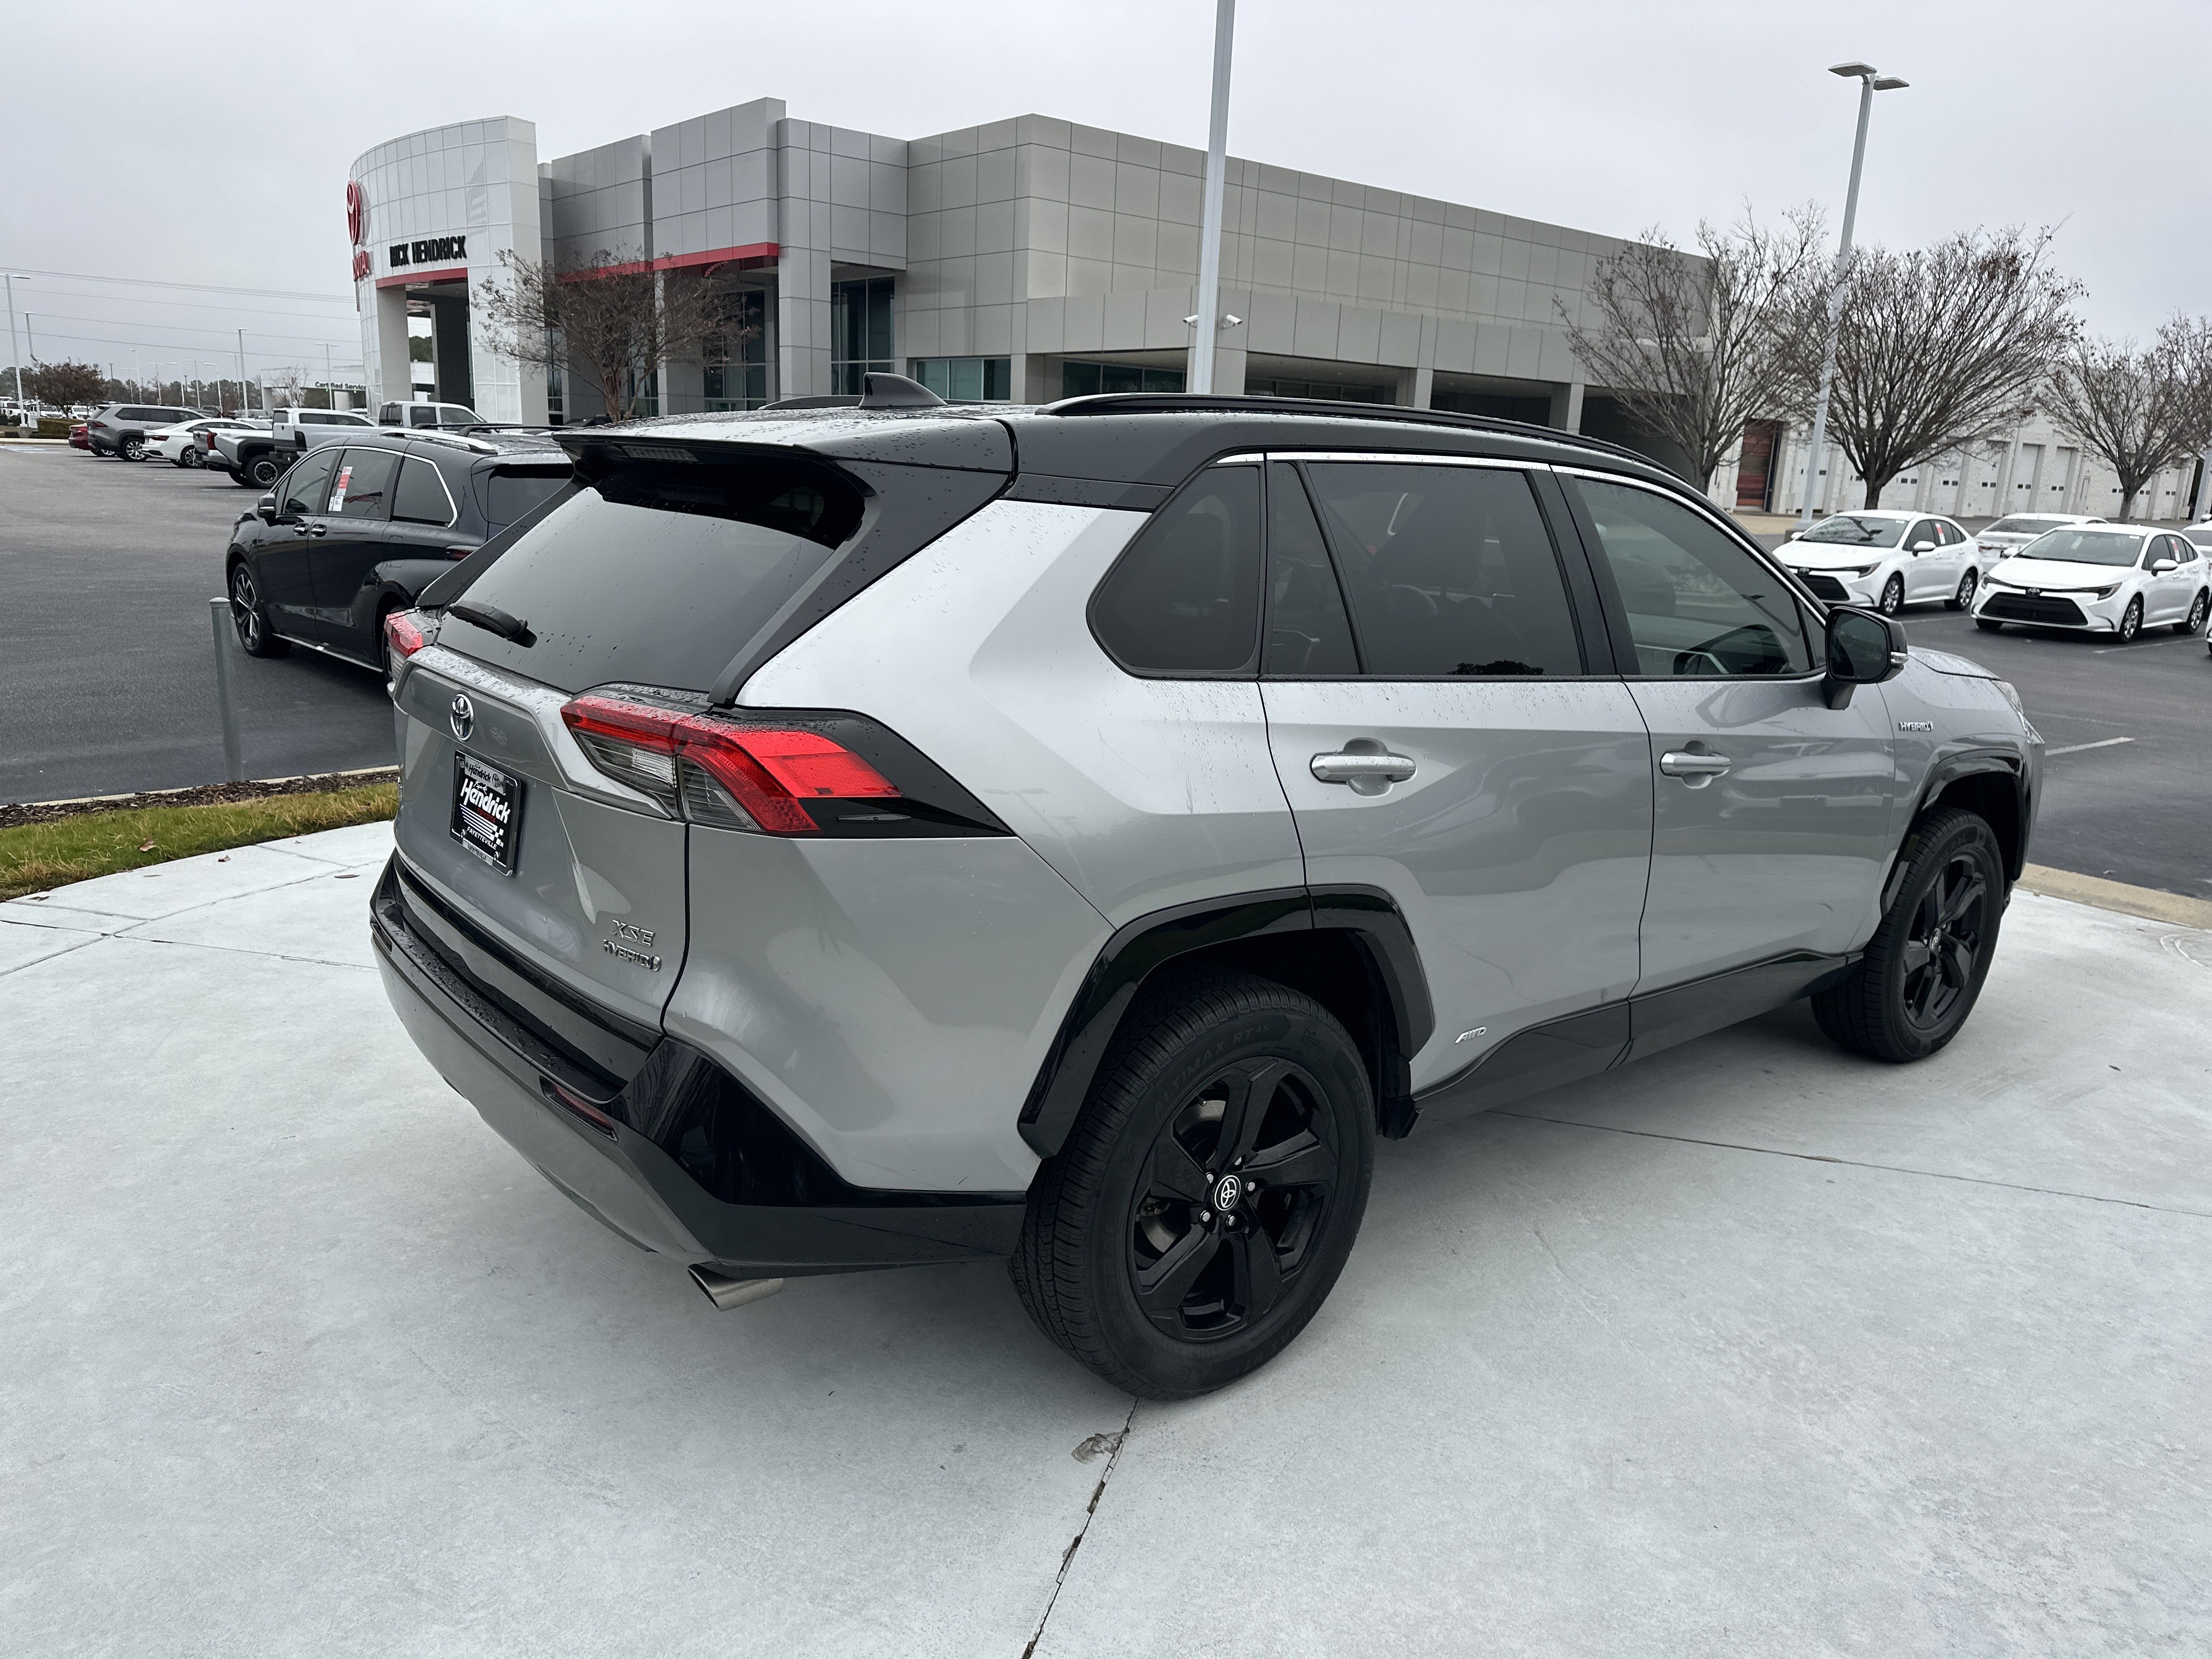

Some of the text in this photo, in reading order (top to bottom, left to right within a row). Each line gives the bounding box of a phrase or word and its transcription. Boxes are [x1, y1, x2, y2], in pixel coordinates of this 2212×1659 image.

[390, 243, 409, 268] RICK
[411, 235, 467, 264] HENDRICK
[1898, 721, 1931, 732] HYBRID
[468, 764, 491, 782] Hendrick
[460, 778, 511, 823] Hendrick
[477, 808, 496, 823] TOYOTA
[467, 826, 497, 850] FAYETTEVILLE
[610, 919, 656, 947] XSE
[603, 939, 651, 969] HYBRID
[1454, 1026, 1486, 1043] AWD
[1155, 1040, 1224, 1117] ALTIMAX
